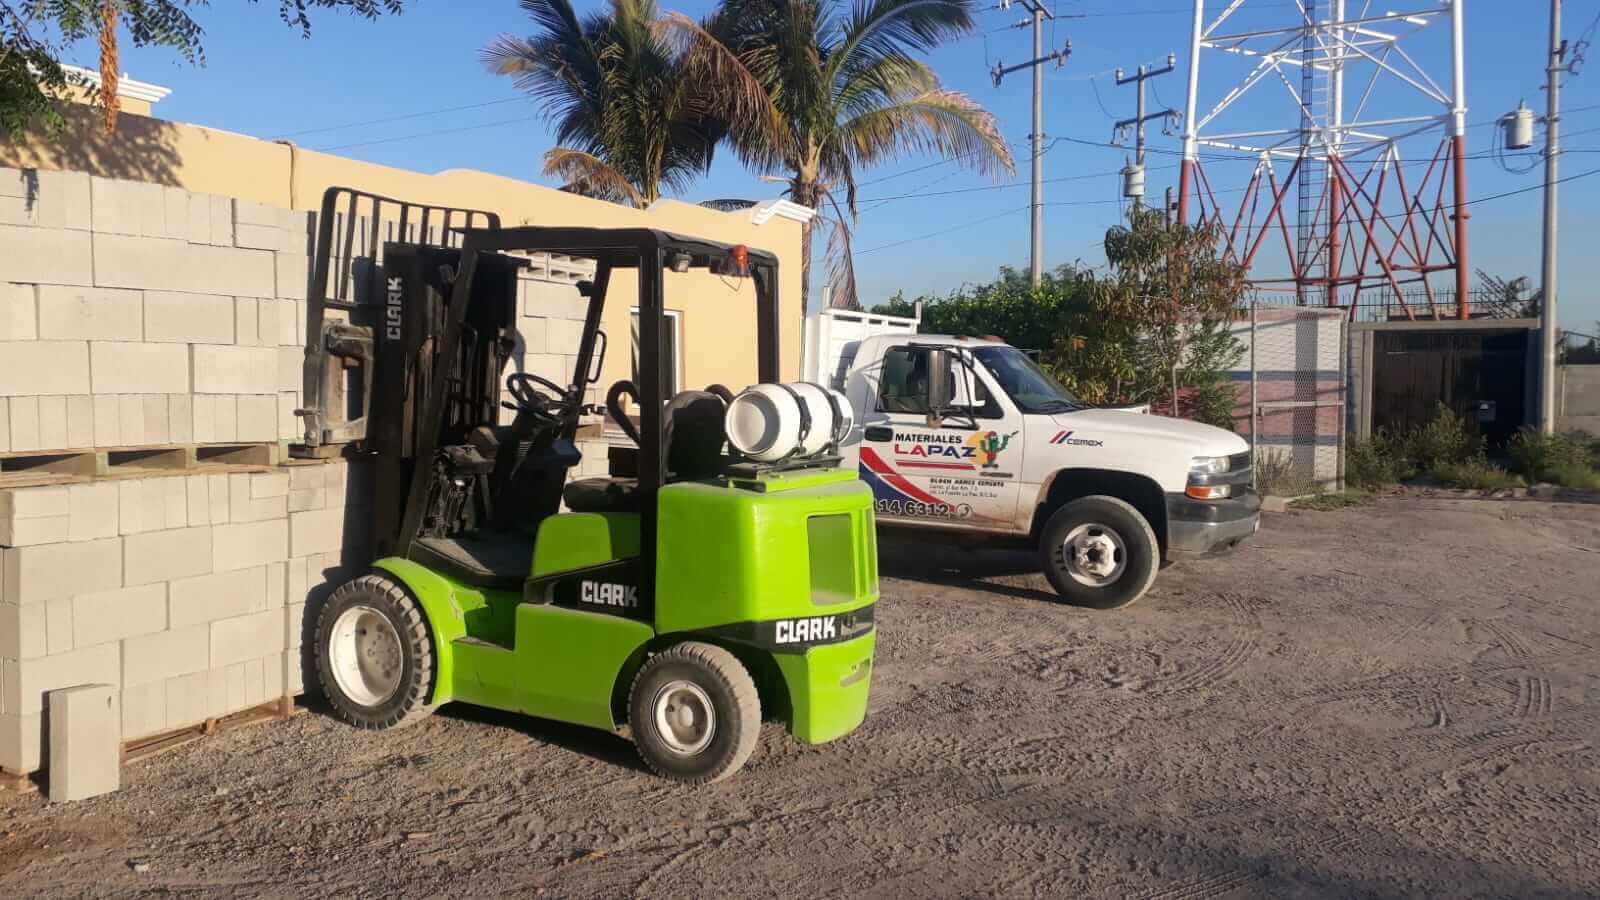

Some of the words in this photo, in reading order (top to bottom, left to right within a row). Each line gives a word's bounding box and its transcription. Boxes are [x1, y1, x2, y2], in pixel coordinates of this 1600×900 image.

[387, 277, 402, 340] CLARK
[895, 433, 962, 444] MATERIALES
[905, 500, 949, 516] 6312
[581, 580, 638, 608] CLARK
[775, 615, 836, 644] CLARK
